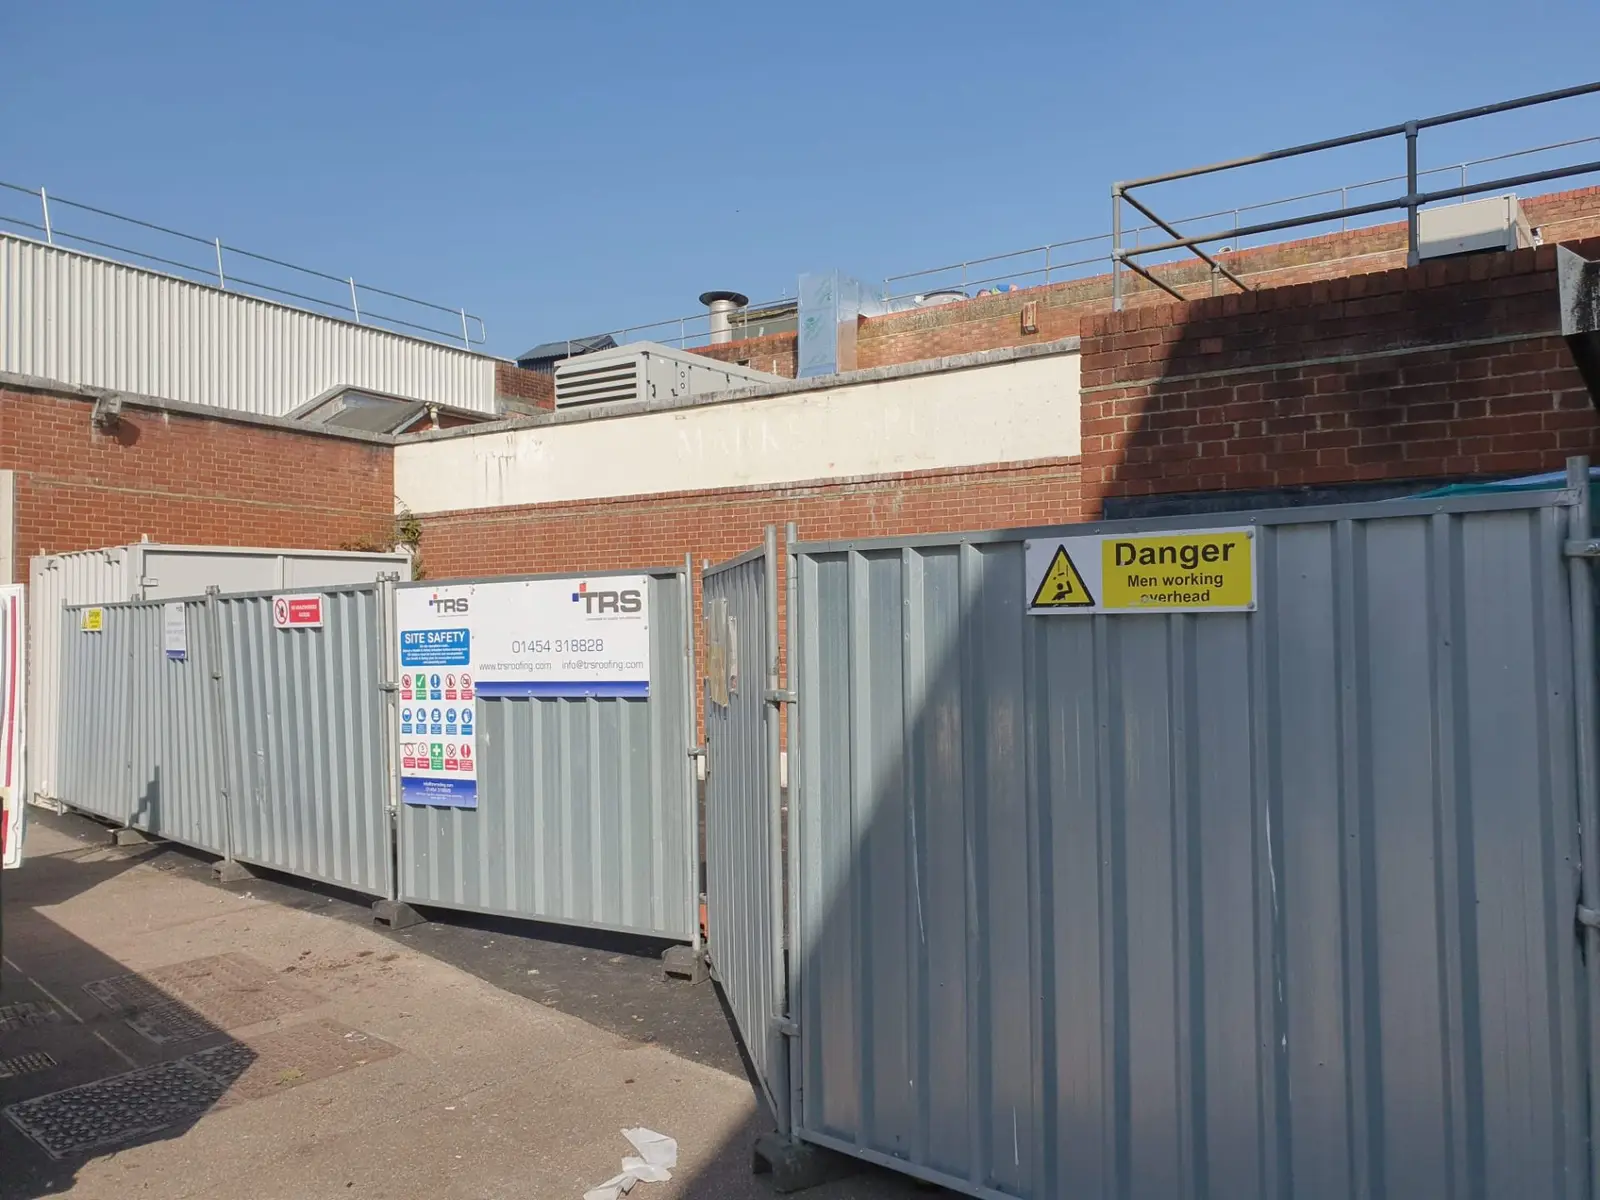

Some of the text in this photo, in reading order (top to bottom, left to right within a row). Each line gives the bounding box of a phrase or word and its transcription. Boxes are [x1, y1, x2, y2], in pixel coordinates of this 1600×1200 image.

[1115, 542, 1236, 570] Danger
[1127, 572, 1224, 588] Men working
[579, 590, 642, 614] TRS
[1140, 590, 1211, 604] overhead
[433, 598, 469, 613] TRS
[404, 631, 466, 644] SITE SAFETY
[512, 639, 604, 654] 01454 318828
[479, 660, 644, 672] www.trsroofing.com info@trsroofing.com
